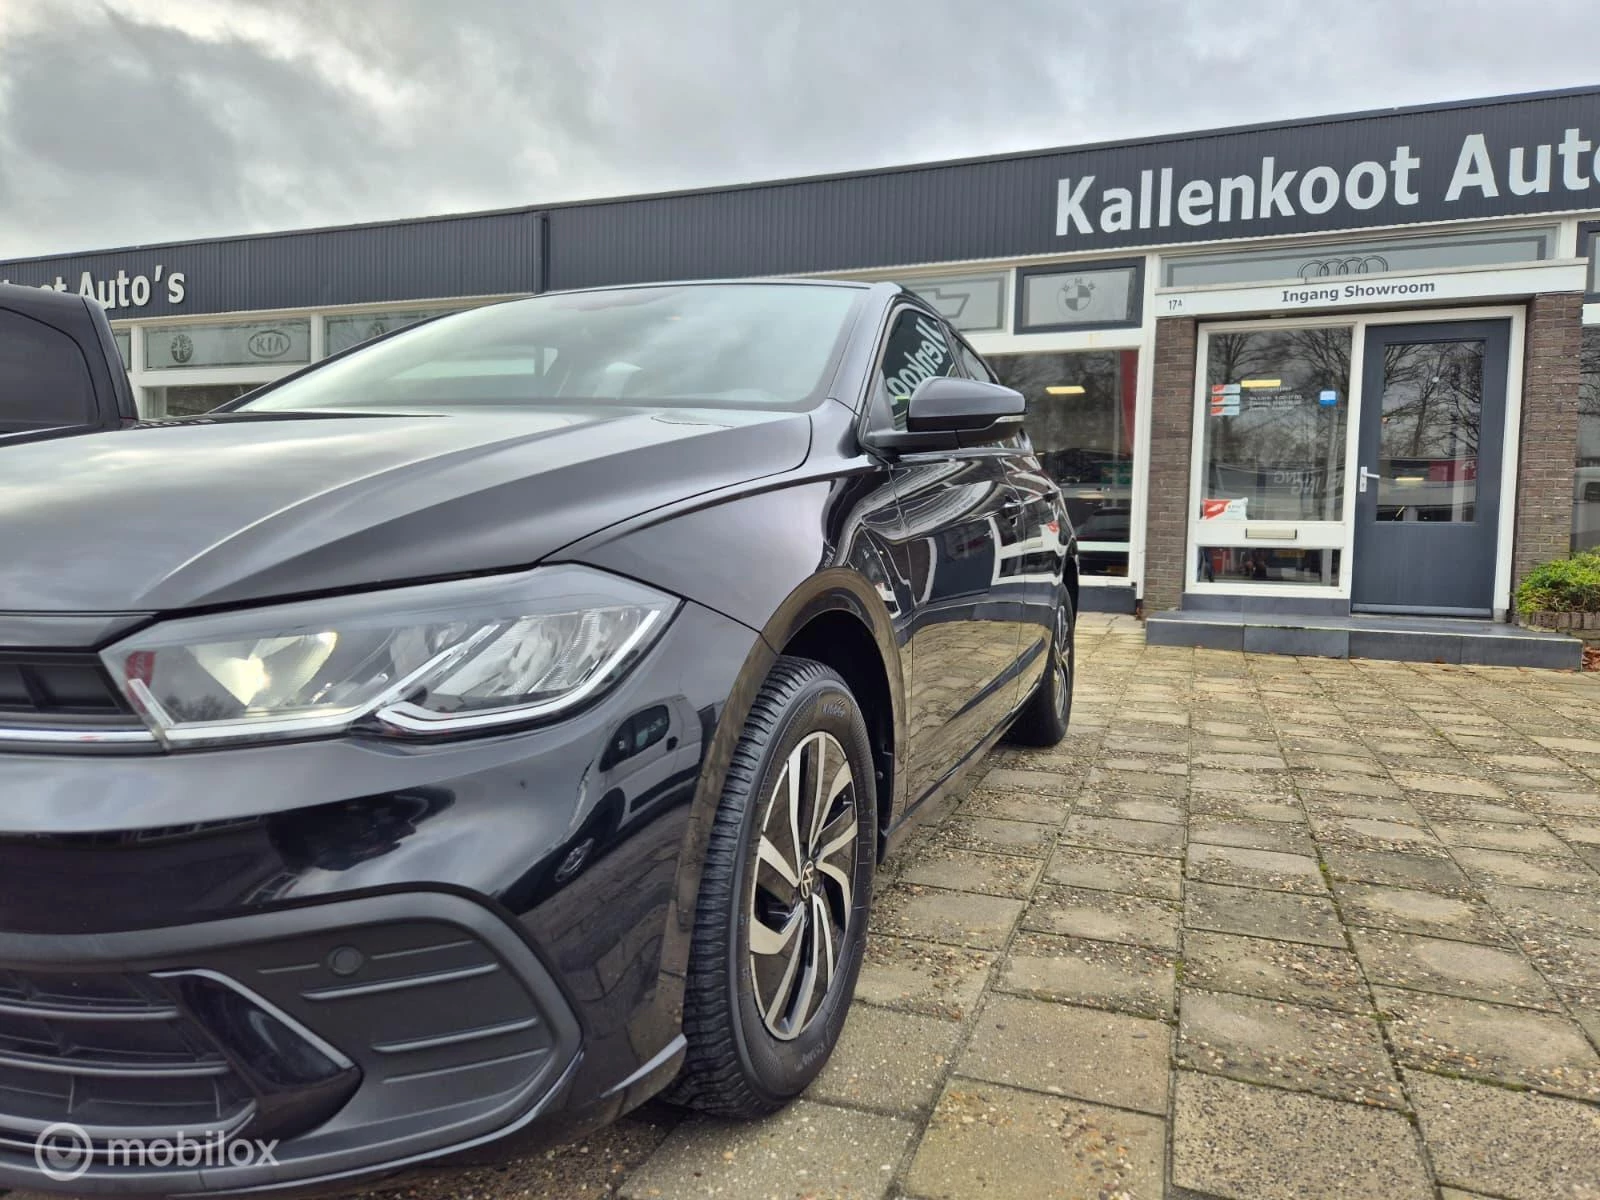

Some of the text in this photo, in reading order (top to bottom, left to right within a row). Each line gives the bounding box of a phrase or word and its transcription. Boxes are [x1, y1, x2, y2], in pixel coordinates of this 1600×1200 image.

[1055, 127, 1600, 237] Kallenkoot Aut
[1281, 281, 1436, 304] Ingang Showroom
[256, 336, 284, 353] KIA
